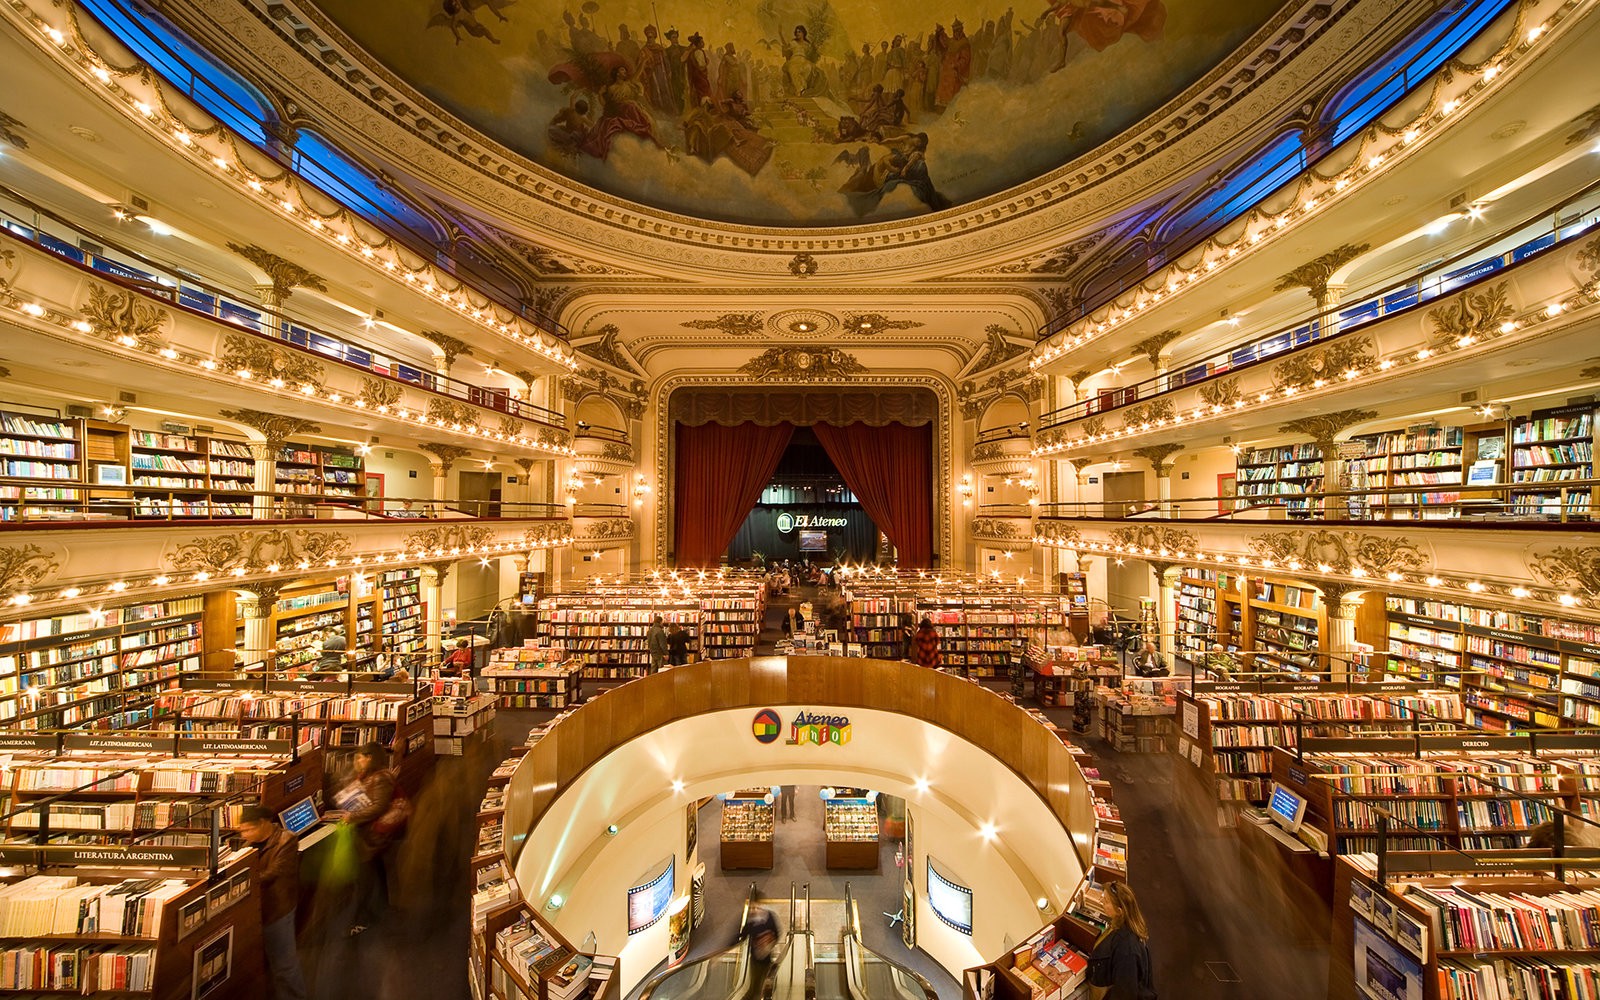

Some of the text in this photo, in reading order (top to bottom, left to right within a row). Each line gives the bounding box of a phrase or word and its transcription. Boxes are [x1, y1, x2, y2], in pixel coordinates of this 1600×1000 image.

[1453, 265, 1494, 282] OMPOSITORES
[794, 515, 848, 528] El Ateneo
[1491, 630, 1523, 641] DICCIONARIOS
[794, 711, 849, 727] Ateneo
[100, 740, 152, 748] LATINOAMERICANA
[74, 851, 174, 861] LITERATURA ARGENTINA
